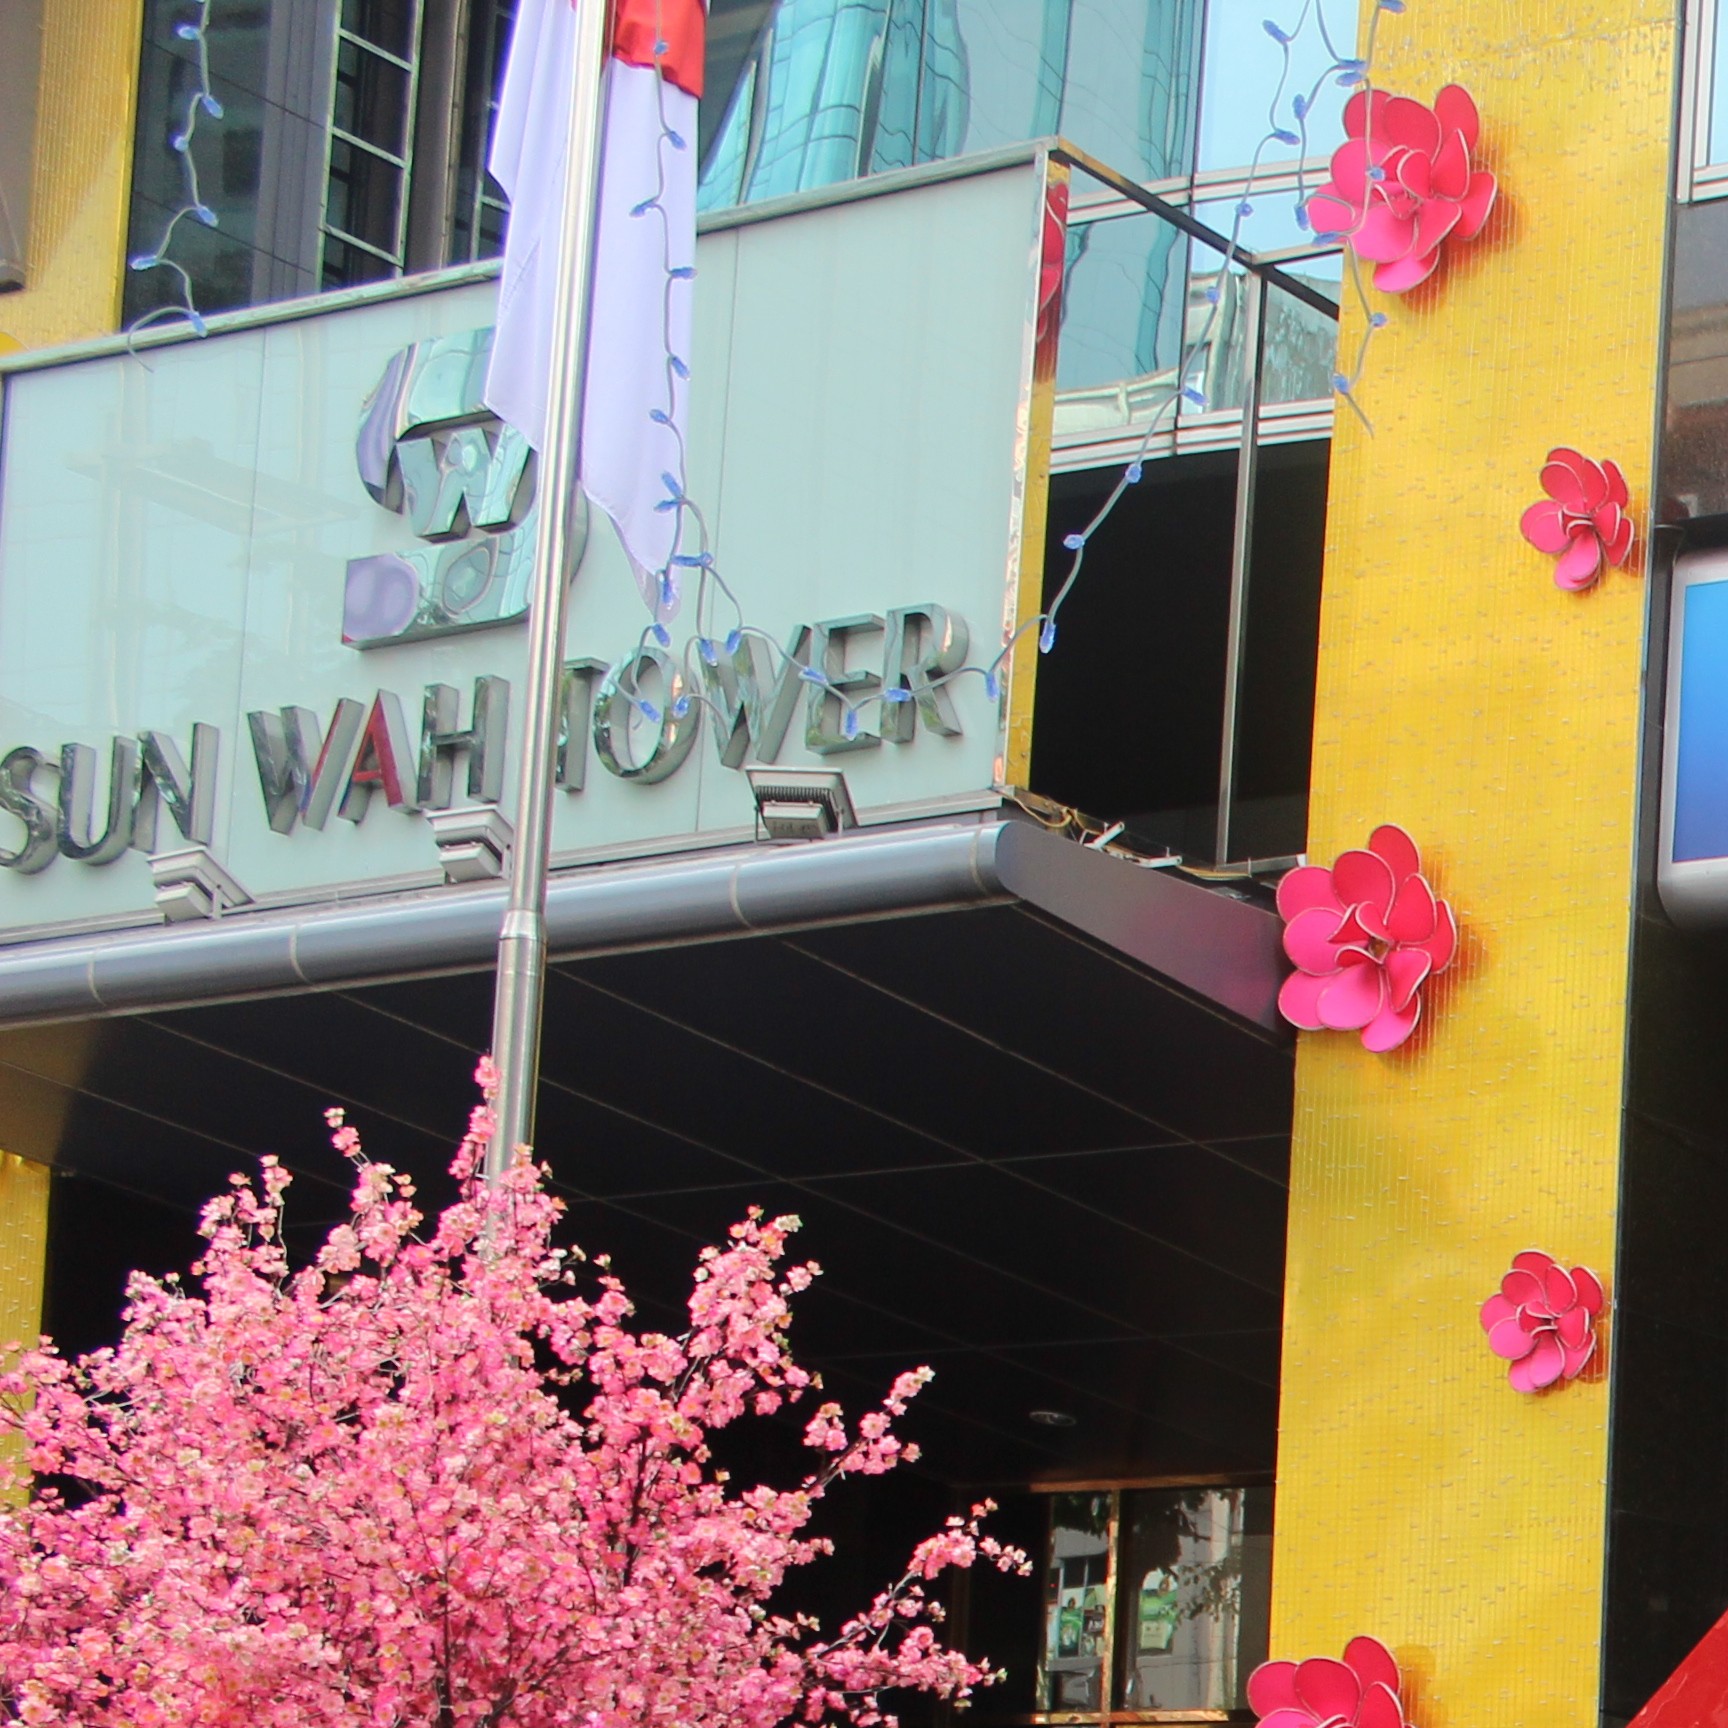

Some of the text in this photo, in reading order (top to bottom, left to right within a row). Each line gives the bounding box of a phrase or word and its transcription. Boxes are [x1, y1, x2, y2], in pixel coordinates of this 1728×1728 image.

[0, 602, 970, 876] SUN WAH TOWER
